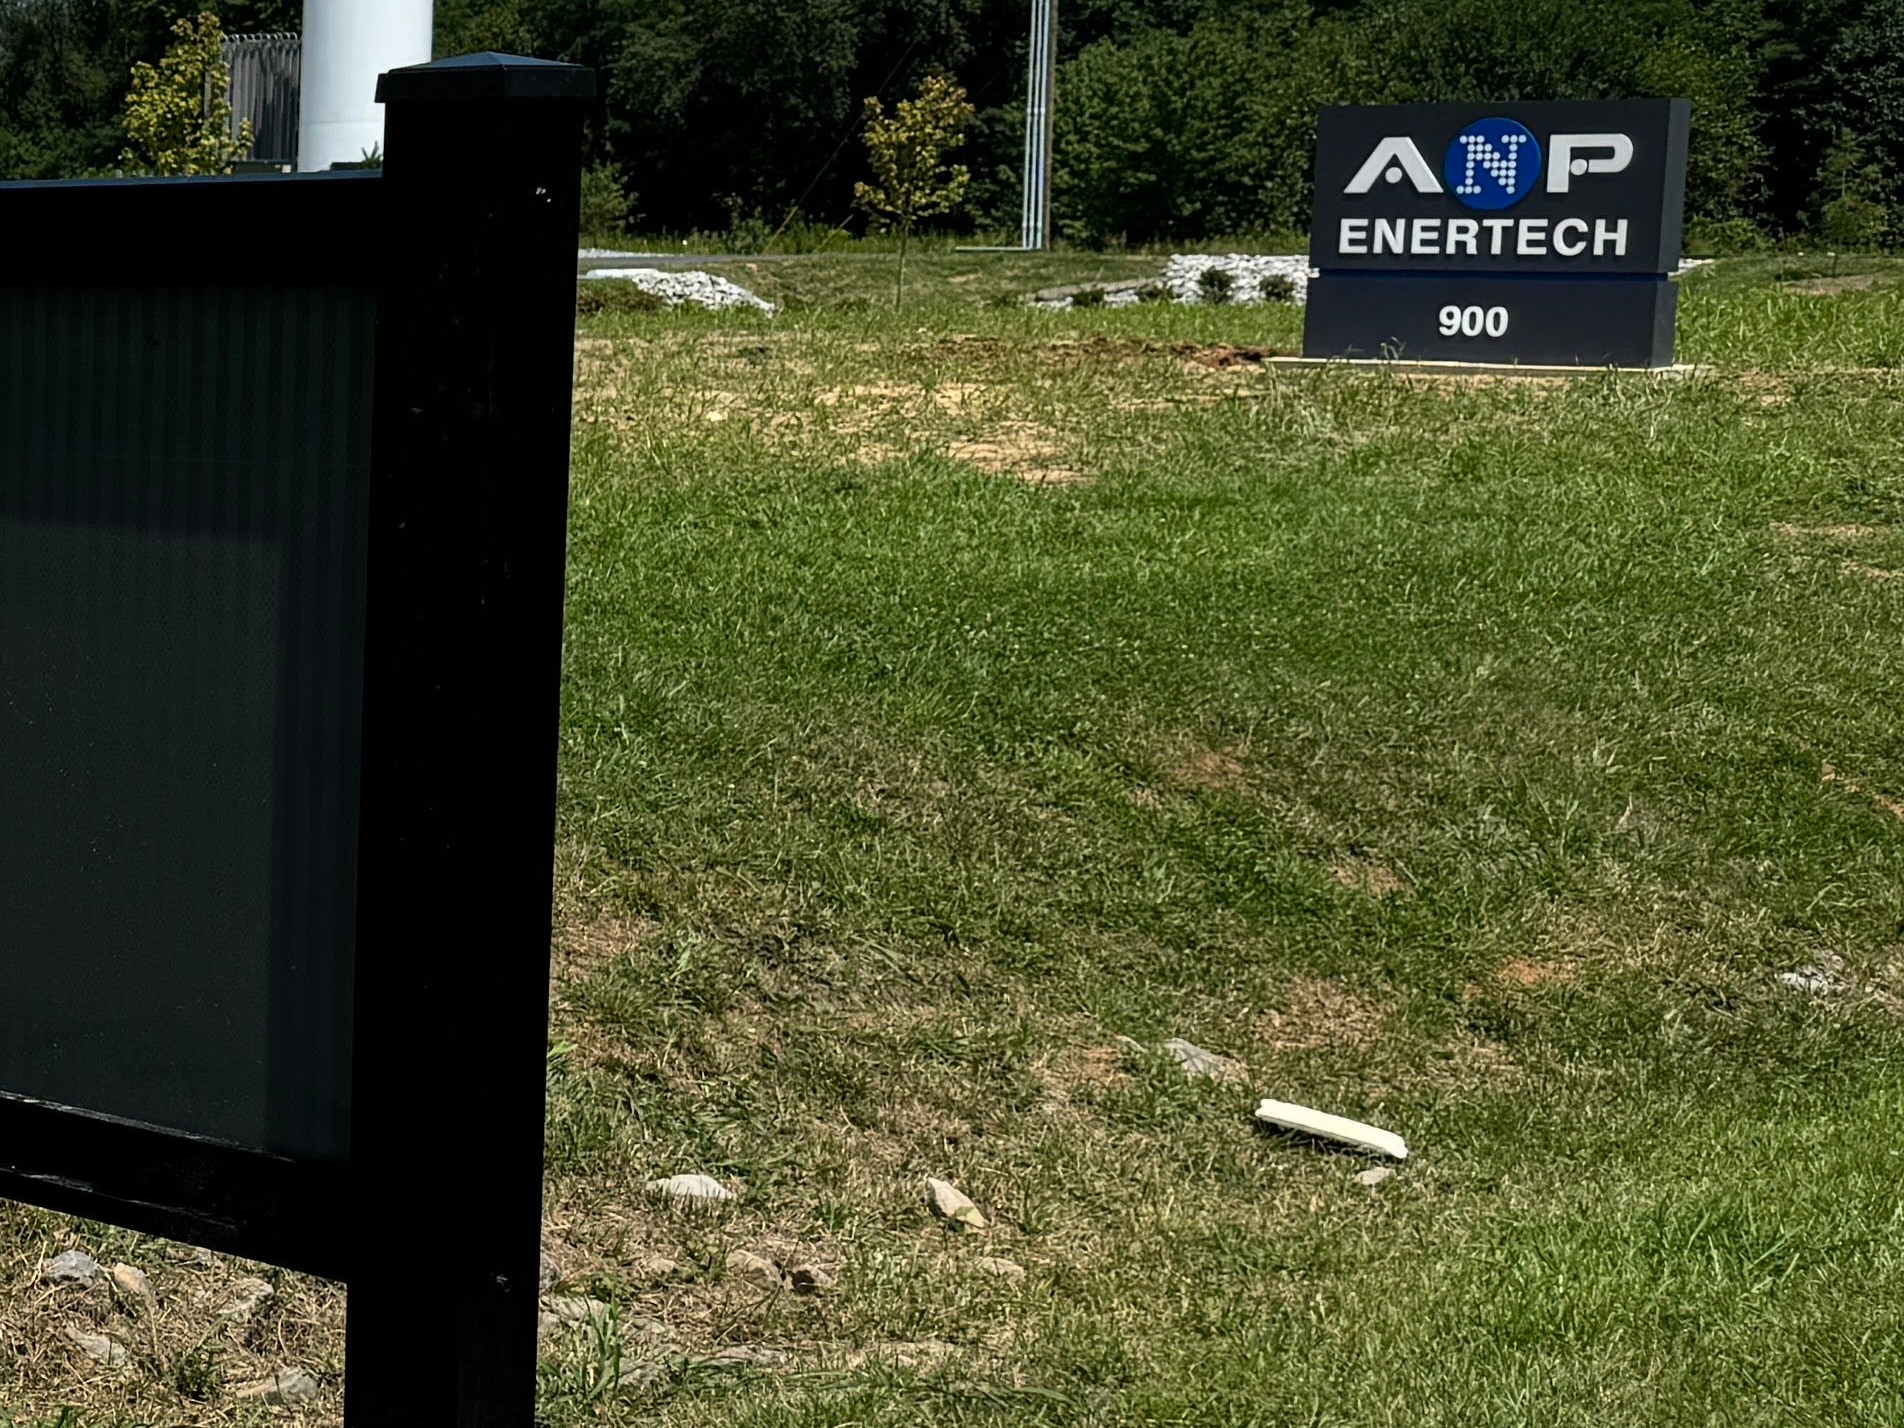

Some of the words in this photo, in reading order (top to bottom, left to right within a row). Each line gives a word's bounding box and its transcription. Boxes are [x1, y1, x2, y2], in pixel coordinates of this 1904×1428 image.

[1343, 133, 1634, 194] ANP
[1338, 217, 1628, 256] ENERTECH
[1439, 305, 1509, 338] 900
